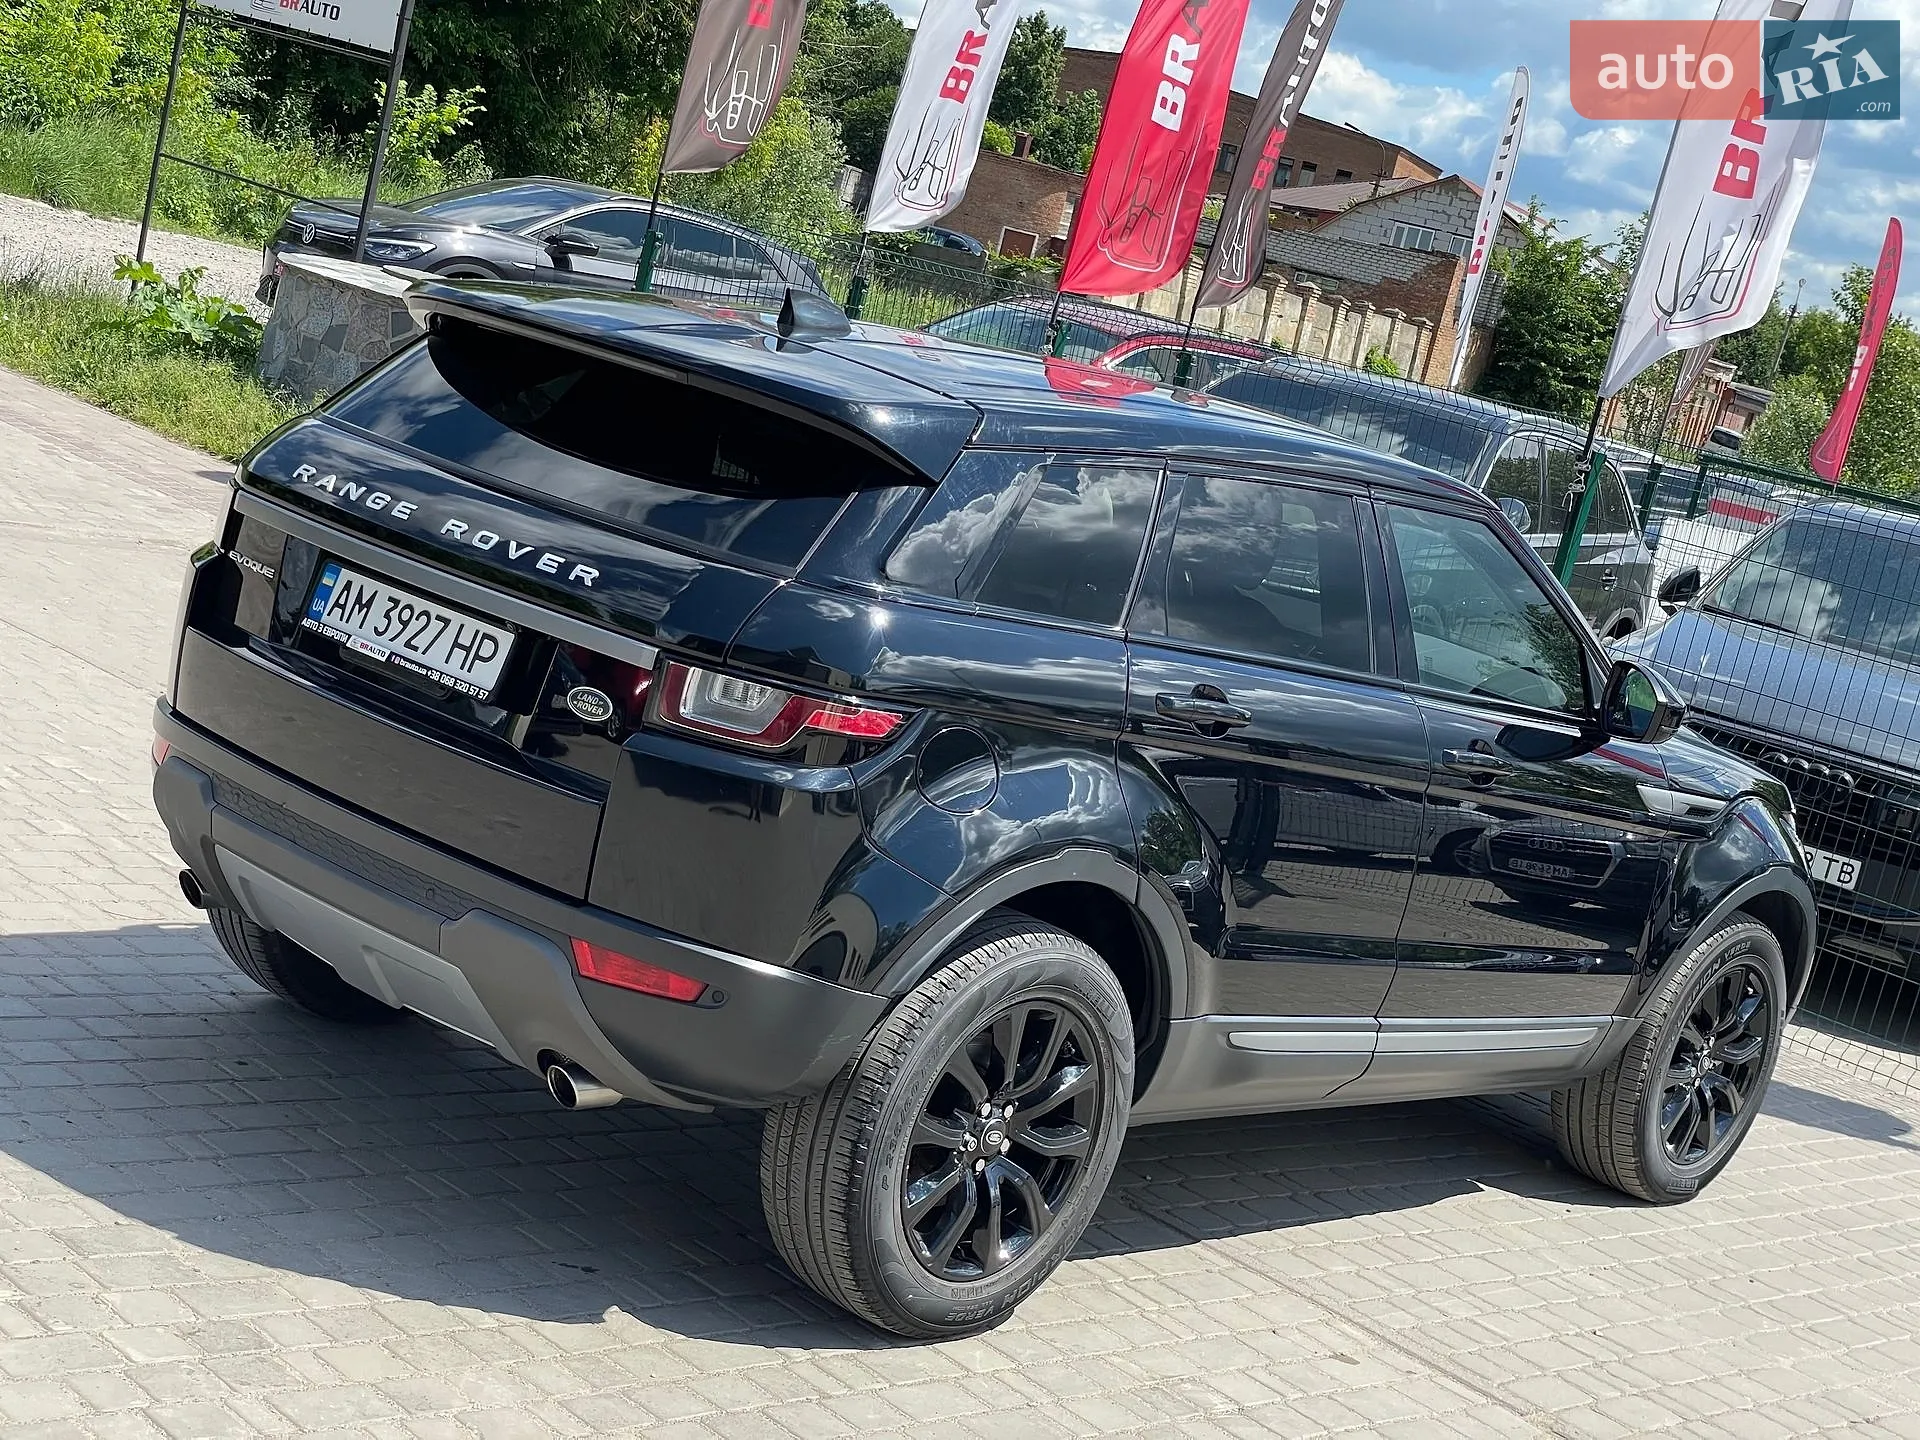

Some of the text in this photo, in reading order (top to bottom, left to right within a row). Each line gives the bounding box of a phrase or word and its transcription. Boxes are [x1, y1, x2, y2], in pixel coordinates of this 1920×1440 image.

[292, 463, 601, 588] RANGE ROVER
[229, 550, 275, 579] EVOQUE
[312, 597, 325, 614] UA
[326, 579, 499, 674] AM 3927 HP
[359, 642, 387, 658] BRAUTO
[576, 701, 604, 715] ROVER
[577, 692, 599, 705] LAND
[1822, 855, 1855, 884] TB
